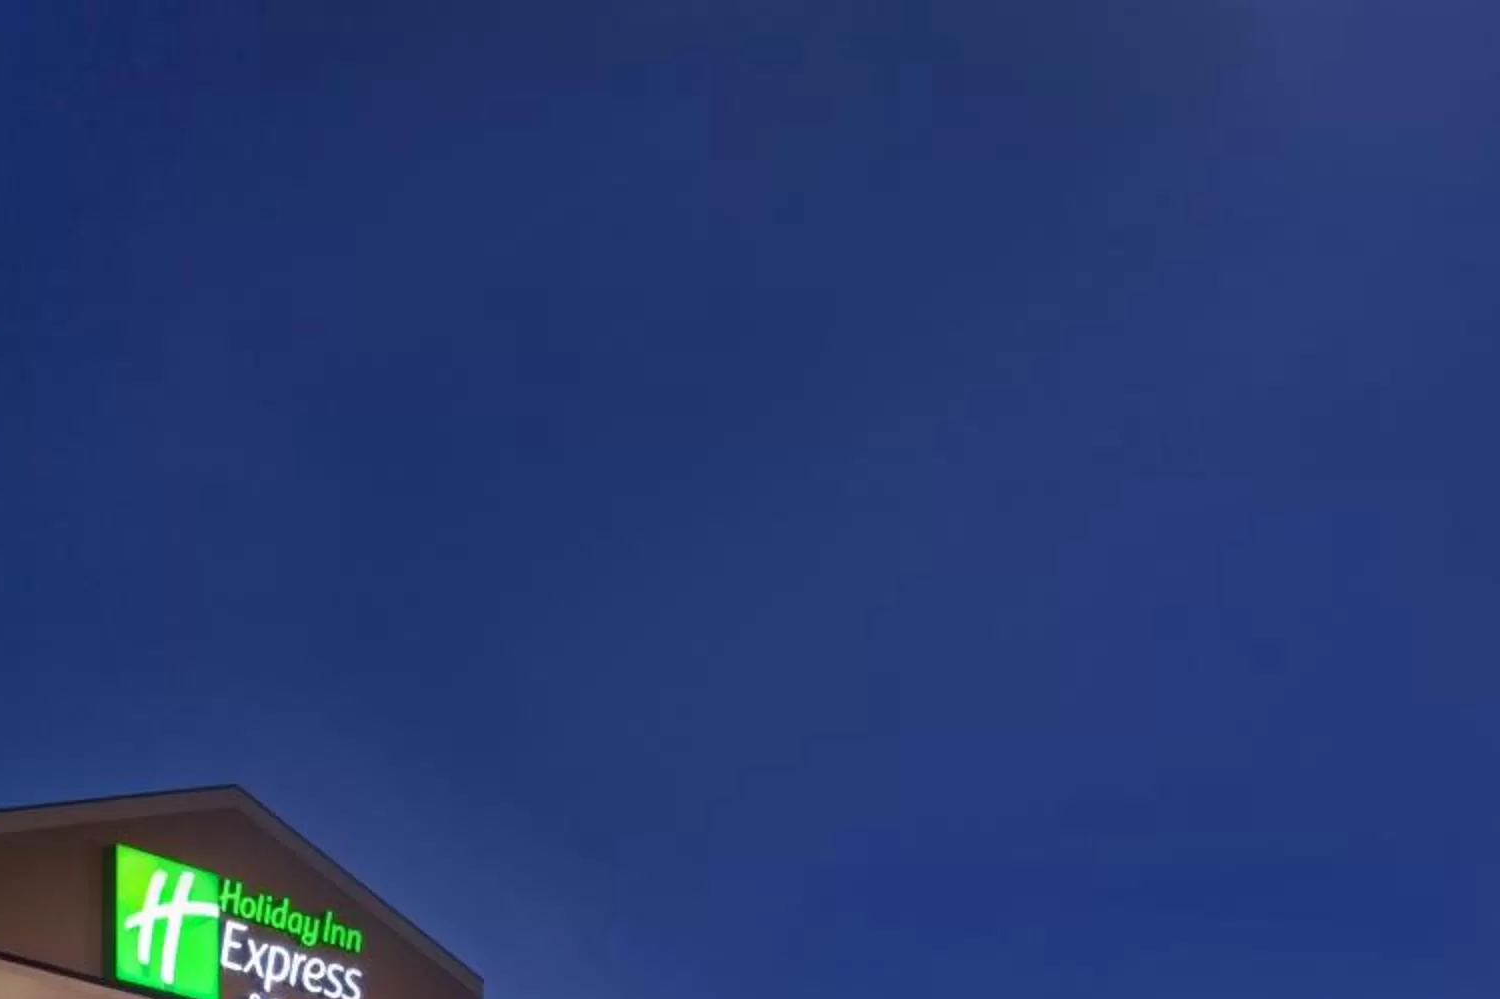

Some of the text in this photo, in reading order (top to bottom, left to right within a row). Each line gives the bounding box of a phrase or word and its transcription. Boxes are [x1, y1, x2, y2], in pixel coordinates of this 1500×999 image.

[125, 869, 220, 985] H
[220, 879, 362, 953] Holiday Inn
